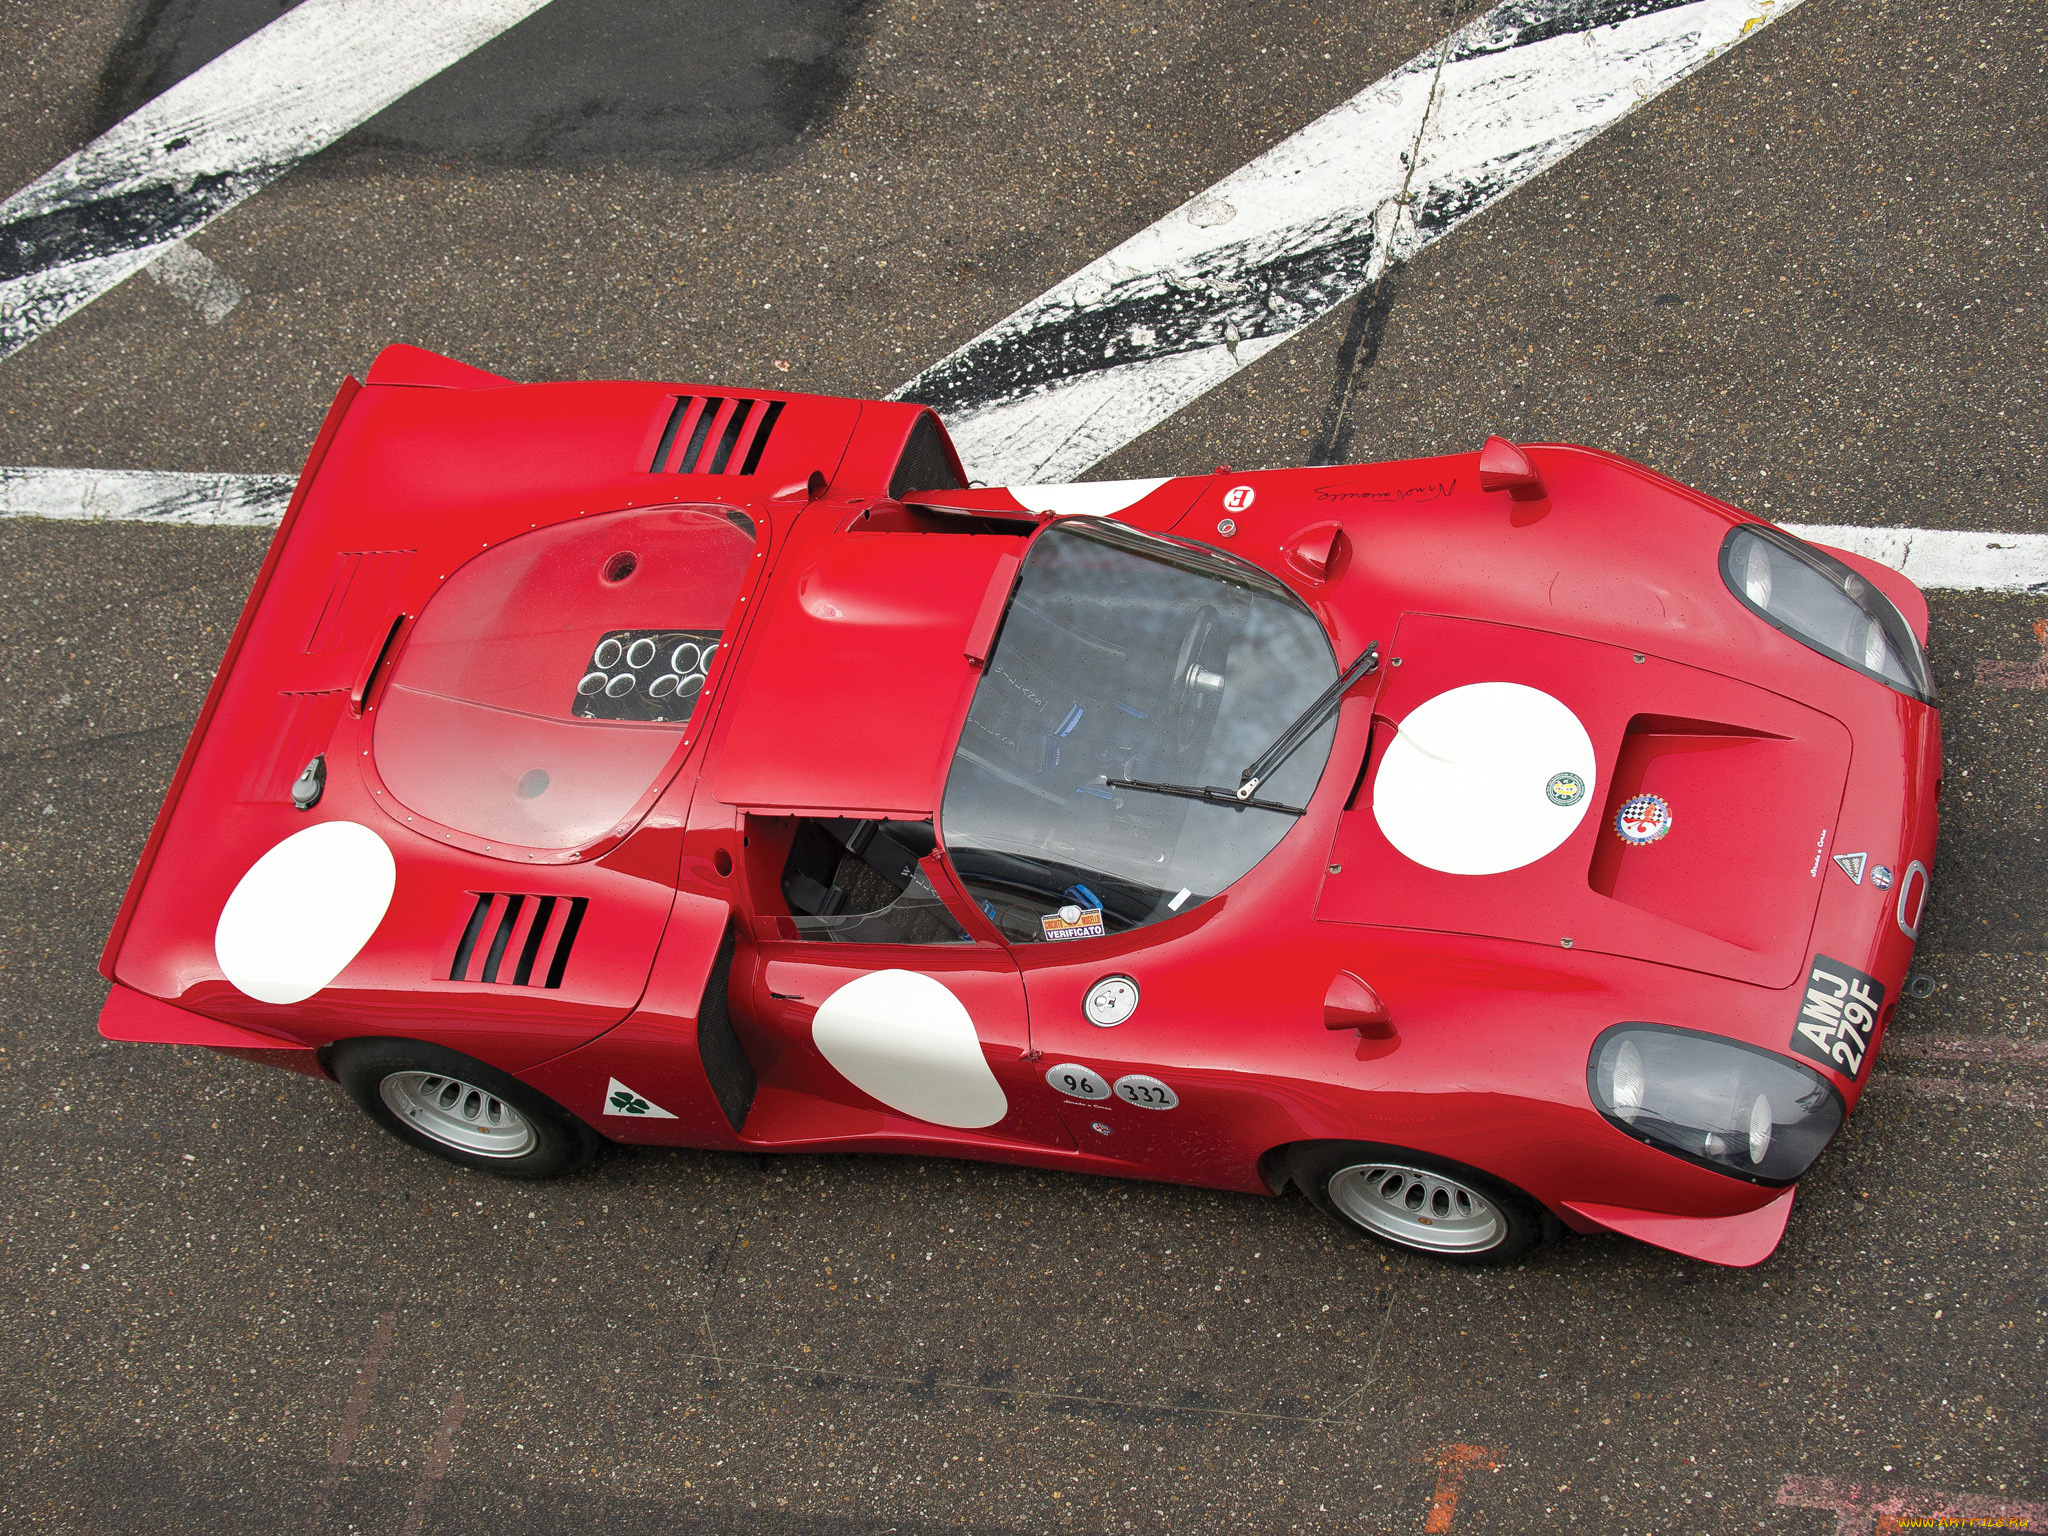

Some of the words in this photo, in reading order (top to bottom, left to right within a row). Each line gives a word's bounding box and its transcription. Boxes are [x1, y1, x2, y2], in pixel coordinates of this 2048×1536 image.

[1229, 489, 1250, 508] E
[1047, 925, 1102, 939] VERIFICATO
[1797, 968, 1849, 1055] AMJ
[1831, 978, 1879, 1075] 279F
[1063, 1074, 1094, 1094] 96
[1123, 1085, 1171, 1104] 332
